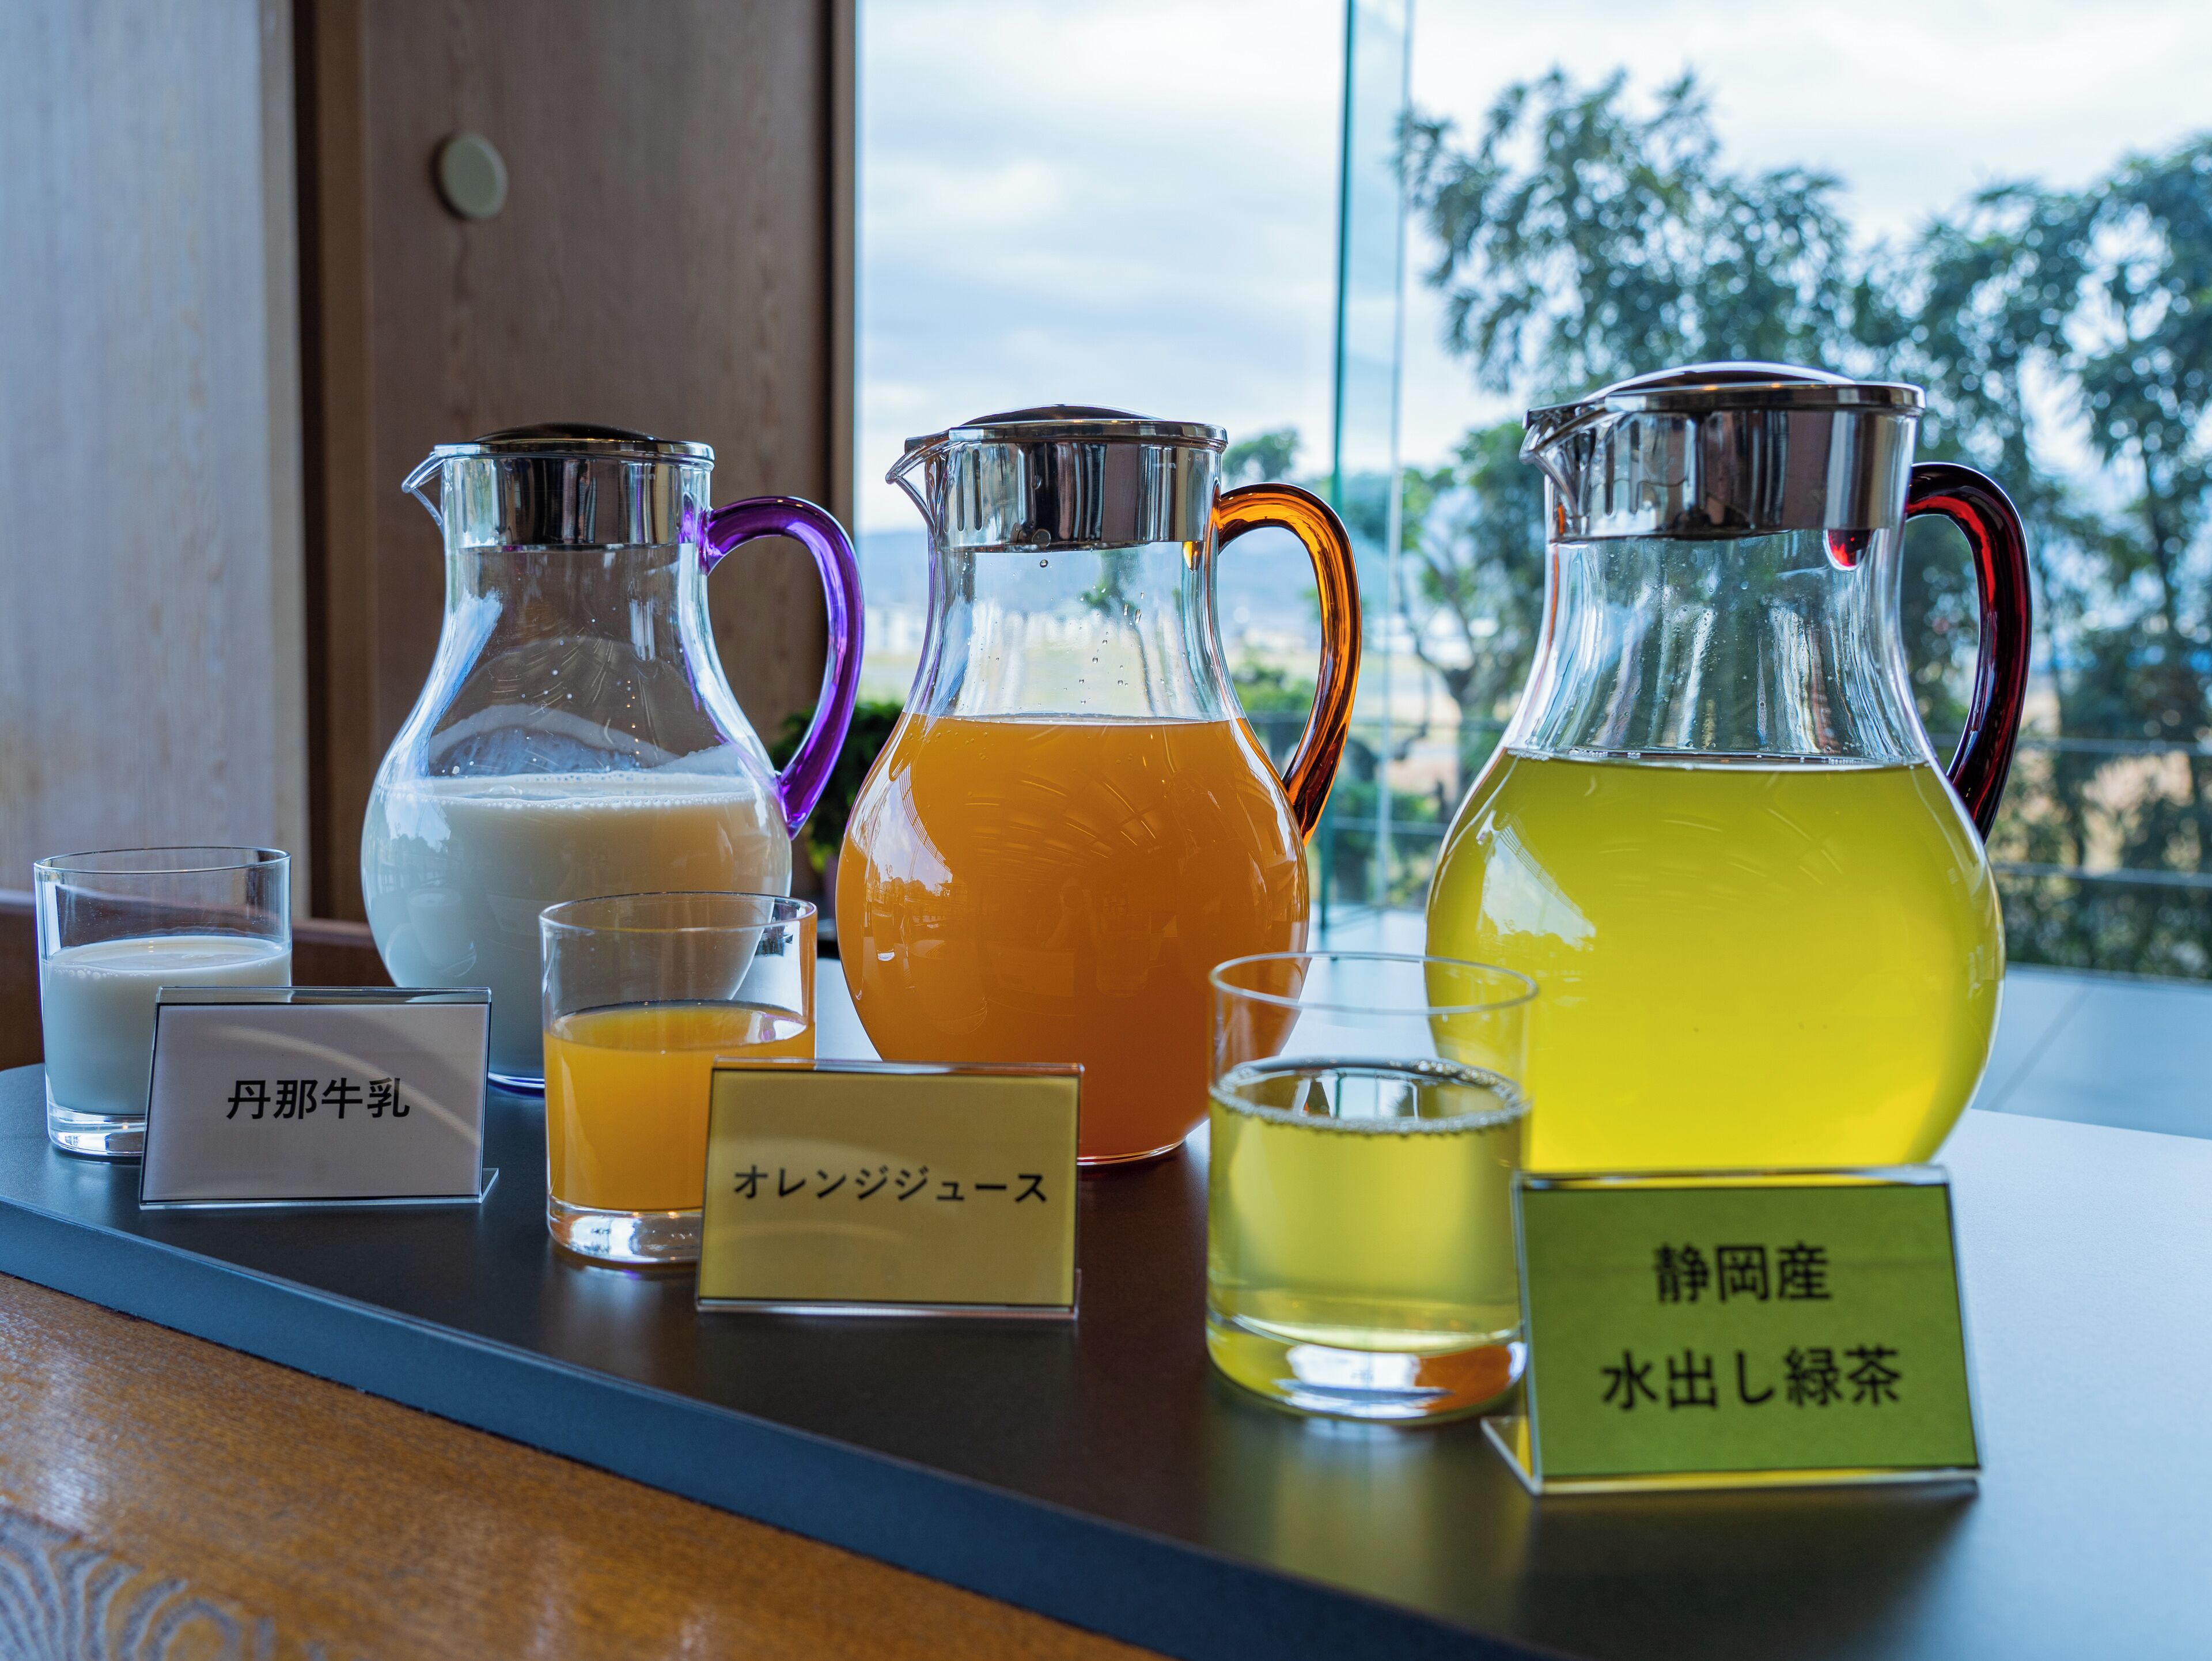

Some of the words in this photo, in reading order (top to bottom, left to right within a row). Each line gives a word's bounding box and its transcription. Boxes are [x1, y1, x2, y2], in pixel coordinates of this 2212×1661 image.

[226, 1077, 410, 1119] 丹那牛乳
[734, 1165, 1047, 1203] オレンジジュース
[1654, 1242, 1832, 1303] 静岡産
[1601, 1345, 1902, 1411] 水出し緑茶
